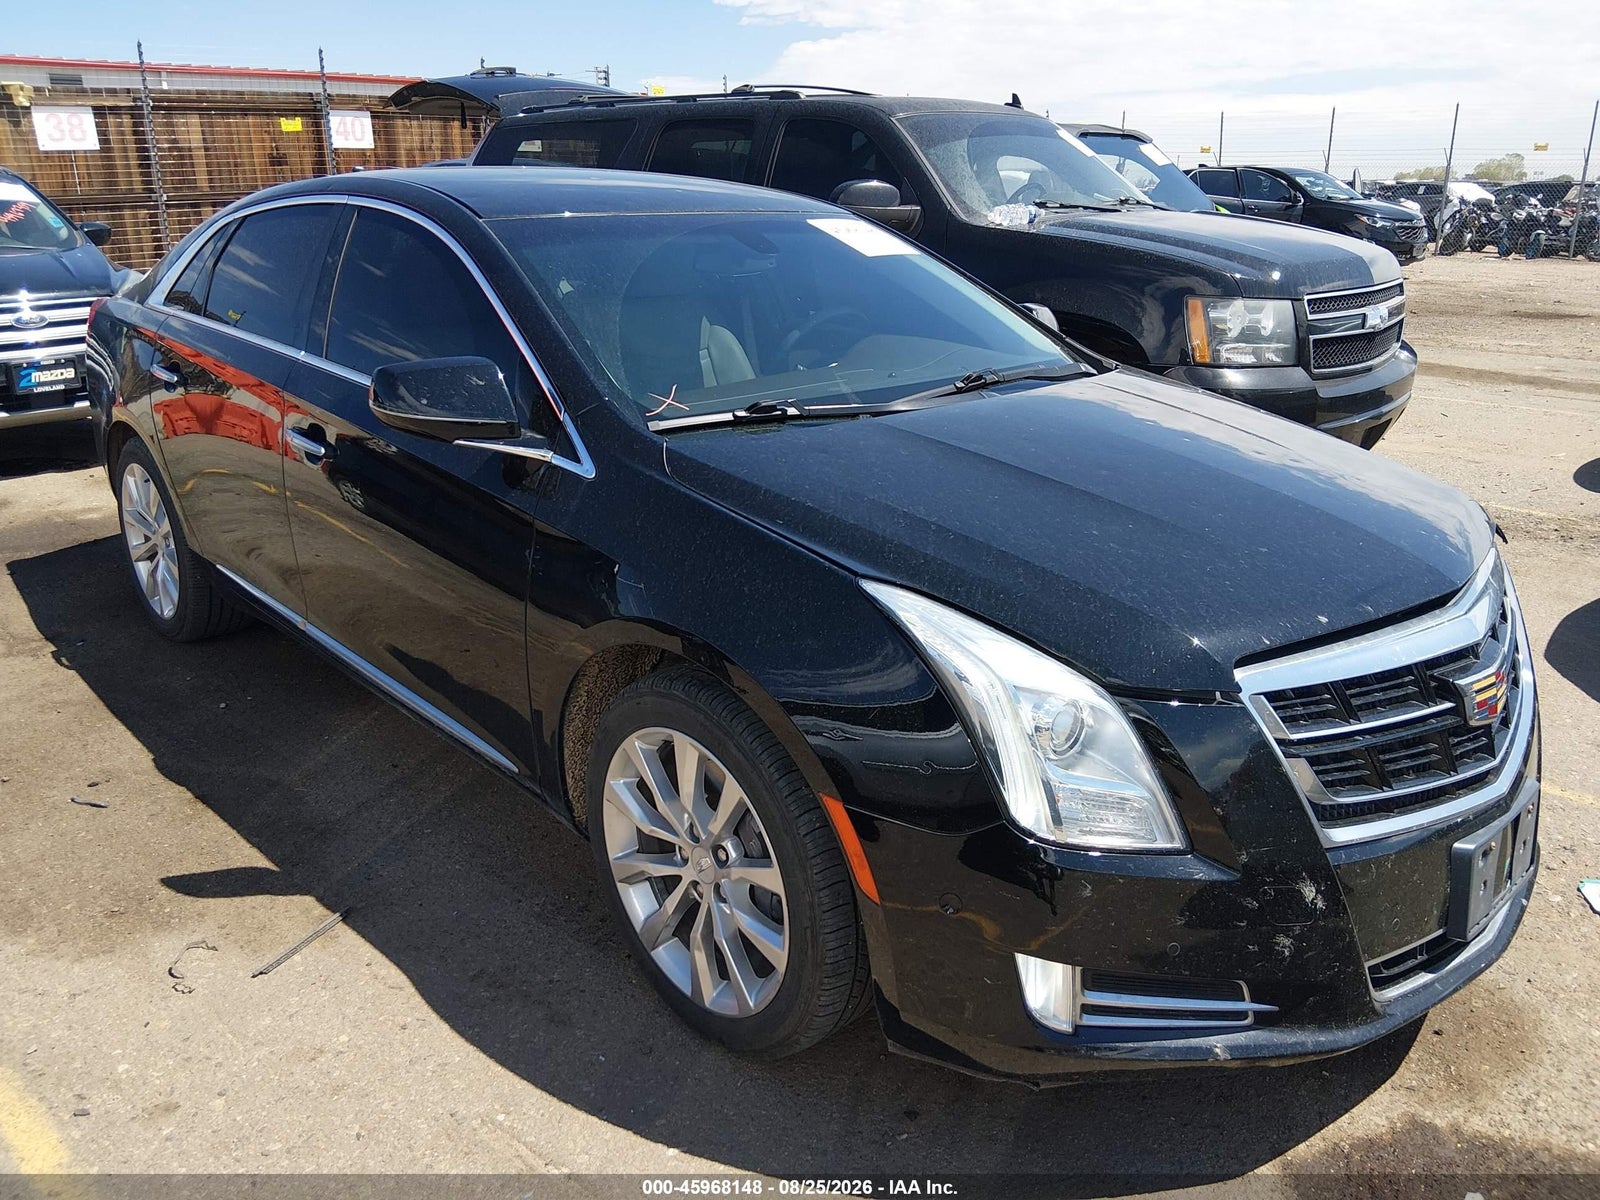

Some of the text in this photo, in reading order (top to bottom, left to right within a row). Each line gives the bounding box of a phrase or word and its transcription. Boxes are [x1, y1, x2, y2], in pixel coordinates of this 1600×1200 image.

[45, 112, 87, 142] 38
[335, 116, 366, 142] 40
[33, 384, 65, 393] LOVELAND
